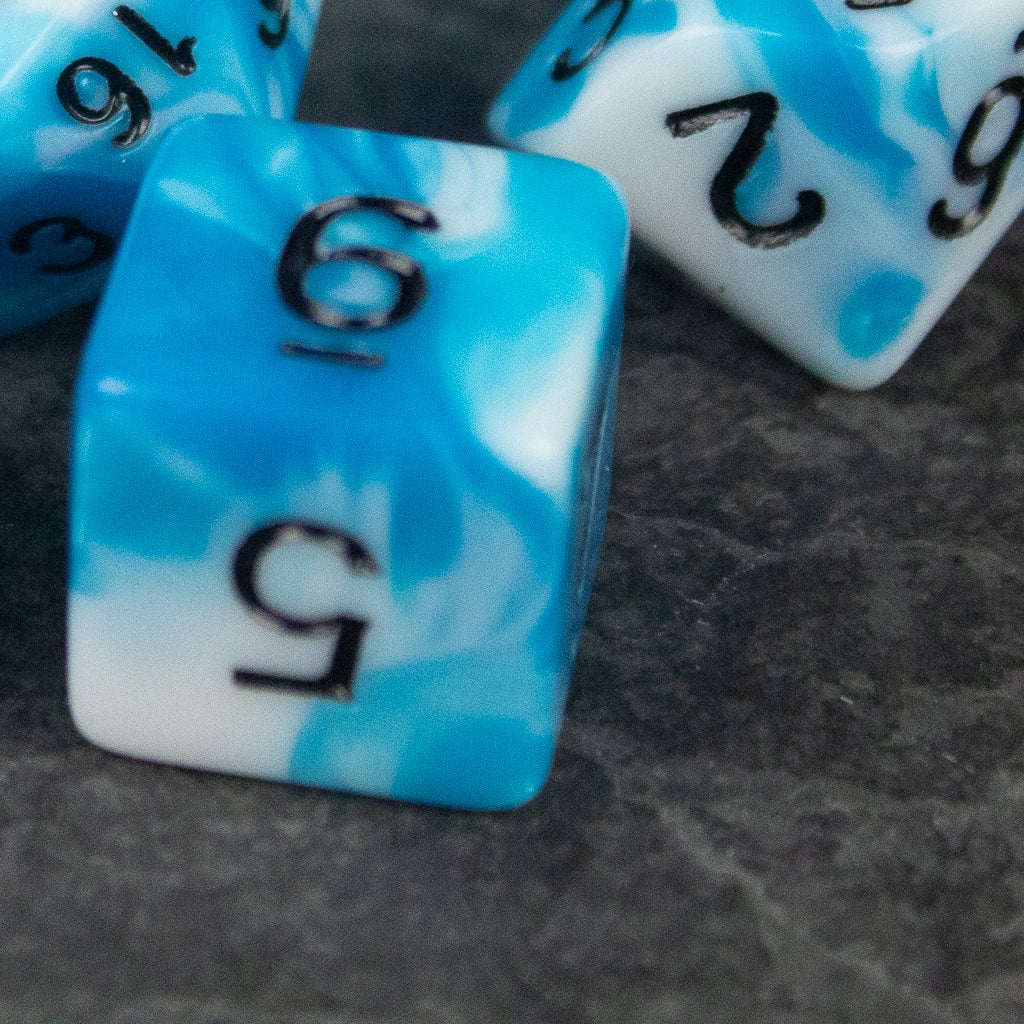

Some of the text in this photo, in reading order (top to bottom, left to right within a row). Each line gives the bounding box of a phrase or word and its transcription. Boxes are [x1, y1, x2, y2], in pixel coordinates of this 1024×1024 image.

[56, 4, 197, 149] 16
[9, 216, 116, 273] 3
[666, 91, 827, 250] 2
[278, 195, 440, 364] 6
[230, 520, 381, 703] 5
